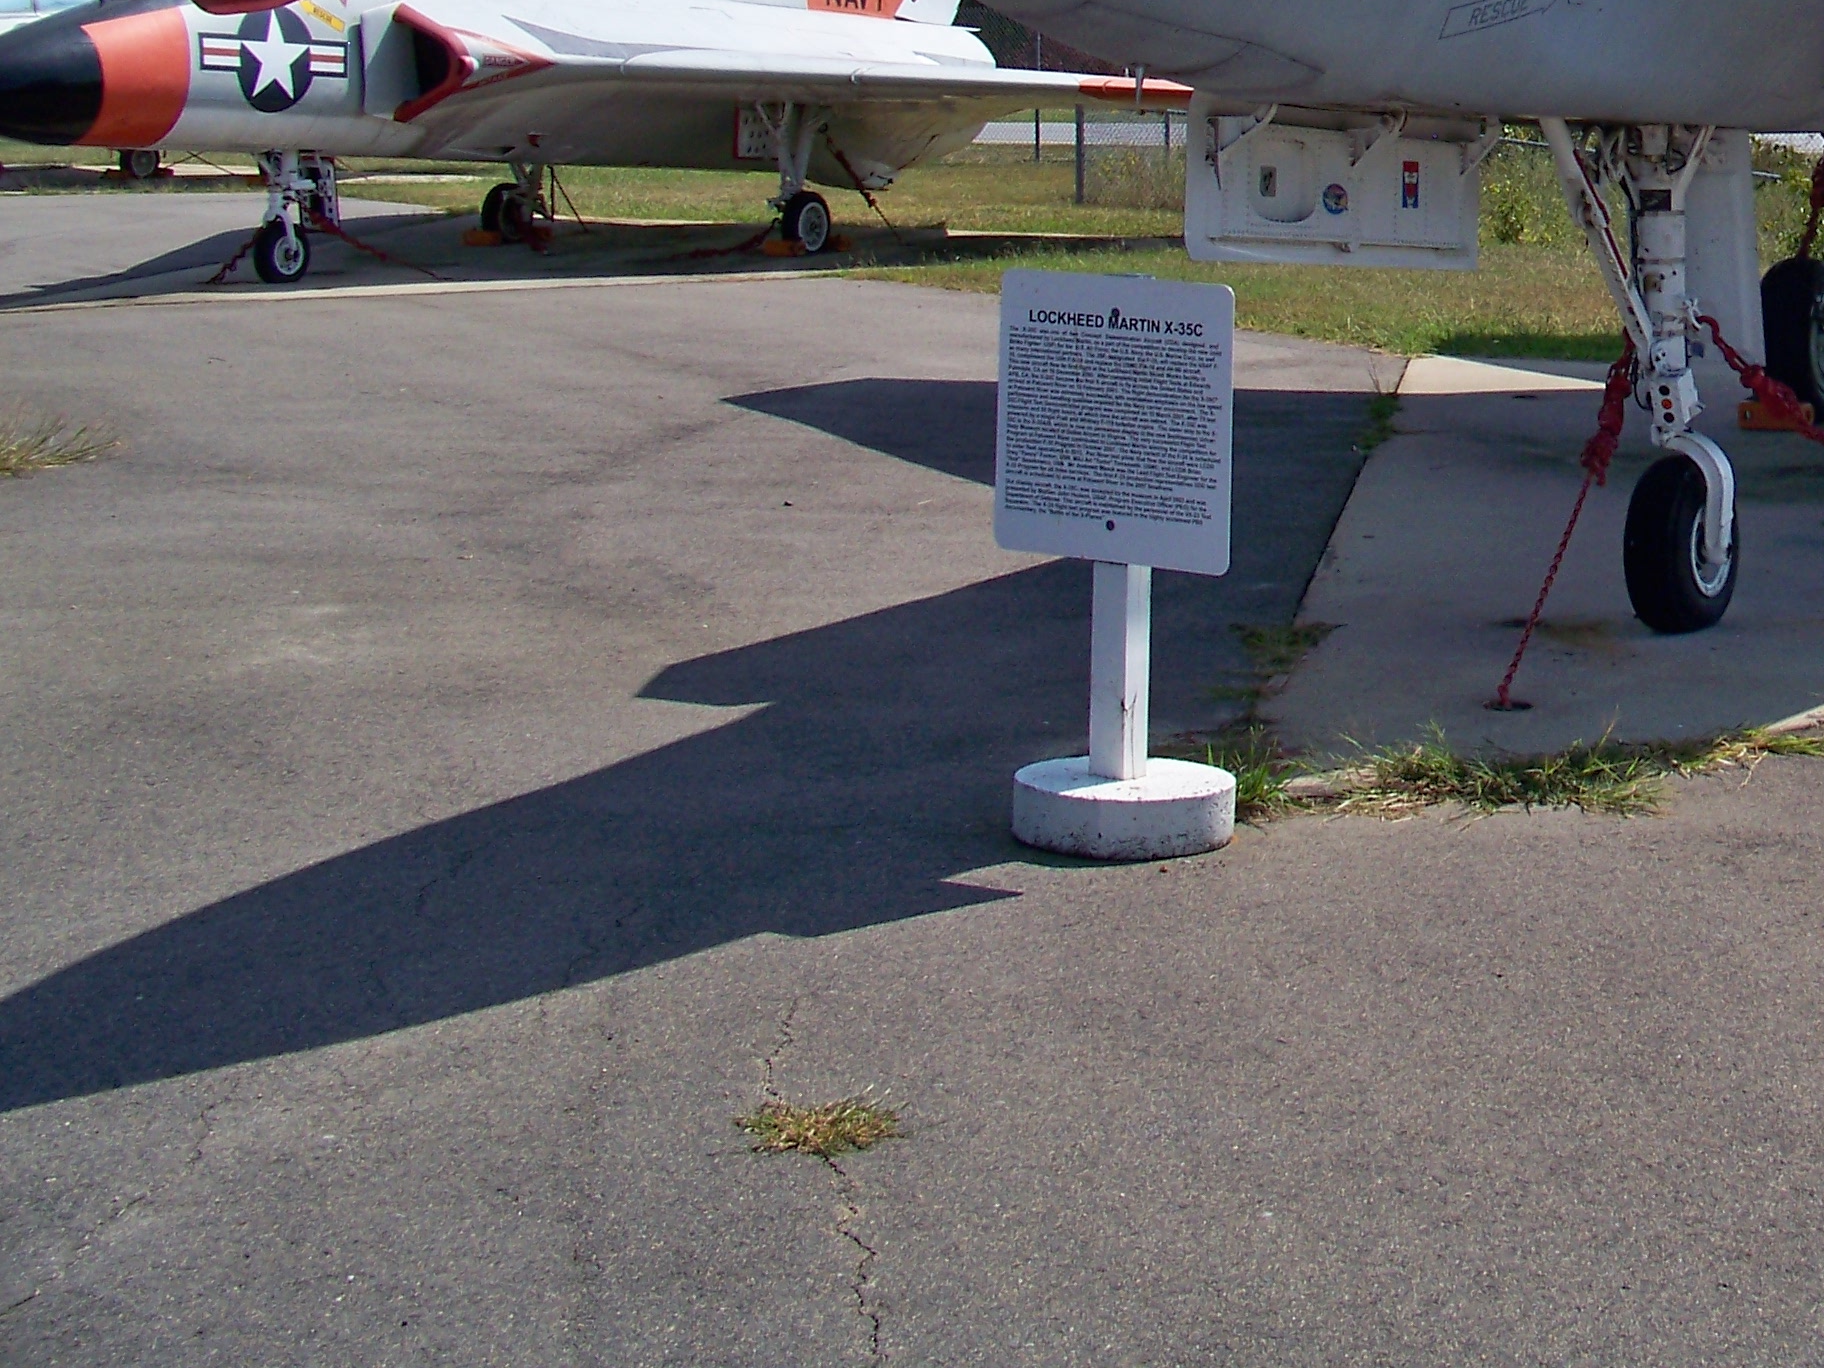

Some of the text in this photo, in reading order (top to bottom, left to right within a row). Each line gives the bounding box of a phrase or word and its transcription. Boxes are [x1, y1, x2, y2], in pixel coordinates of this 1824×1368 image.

[1029, 308, 1204, 337] LOCKHEED MARTIN X-35C
